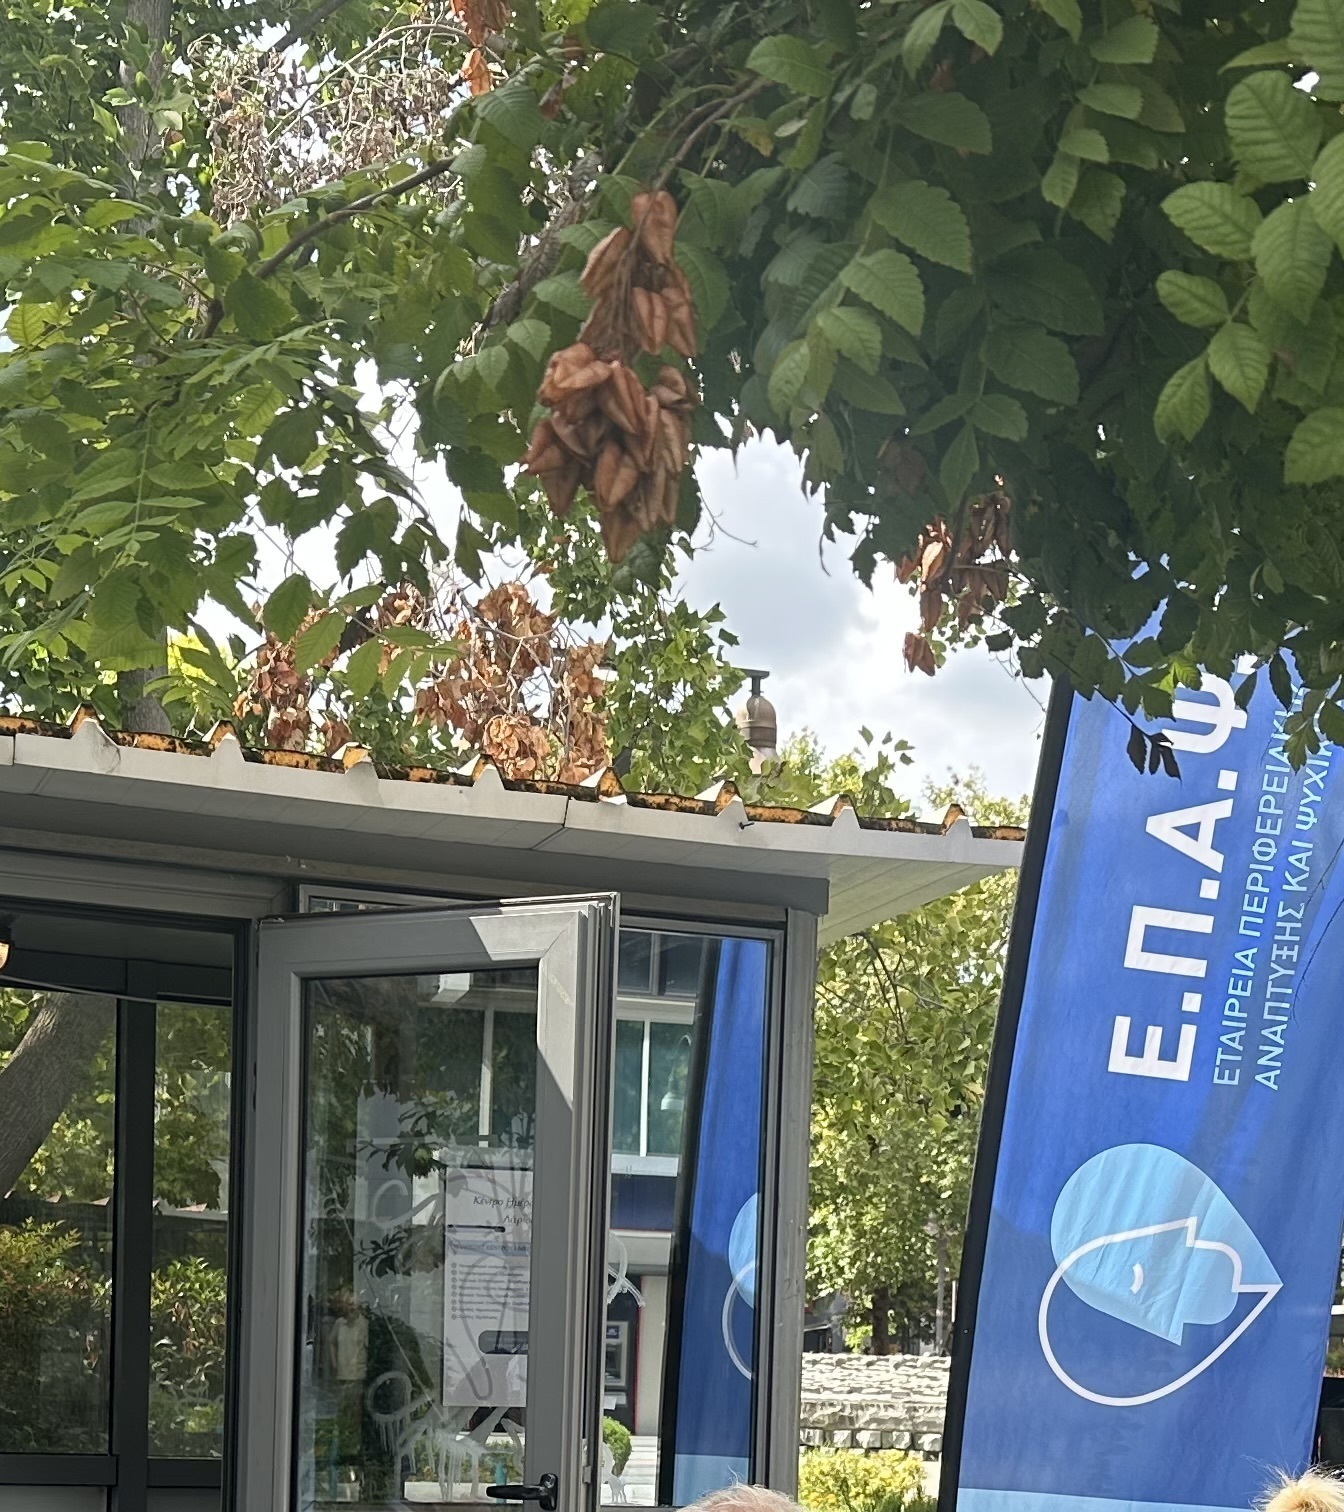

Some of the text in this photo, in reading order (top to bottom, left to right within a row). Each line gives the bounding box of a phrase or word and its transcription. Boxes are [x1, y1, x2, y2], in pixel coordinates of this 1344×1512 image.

[1213, 946, 1259, 1086] ΕΤΑΙΡΕΙΑ
[1254, 902, 1306, 1090] ΑΝΑΠΤΥΞΗΣ
[1282, 839, 1315, 892] ΚΑΙ
